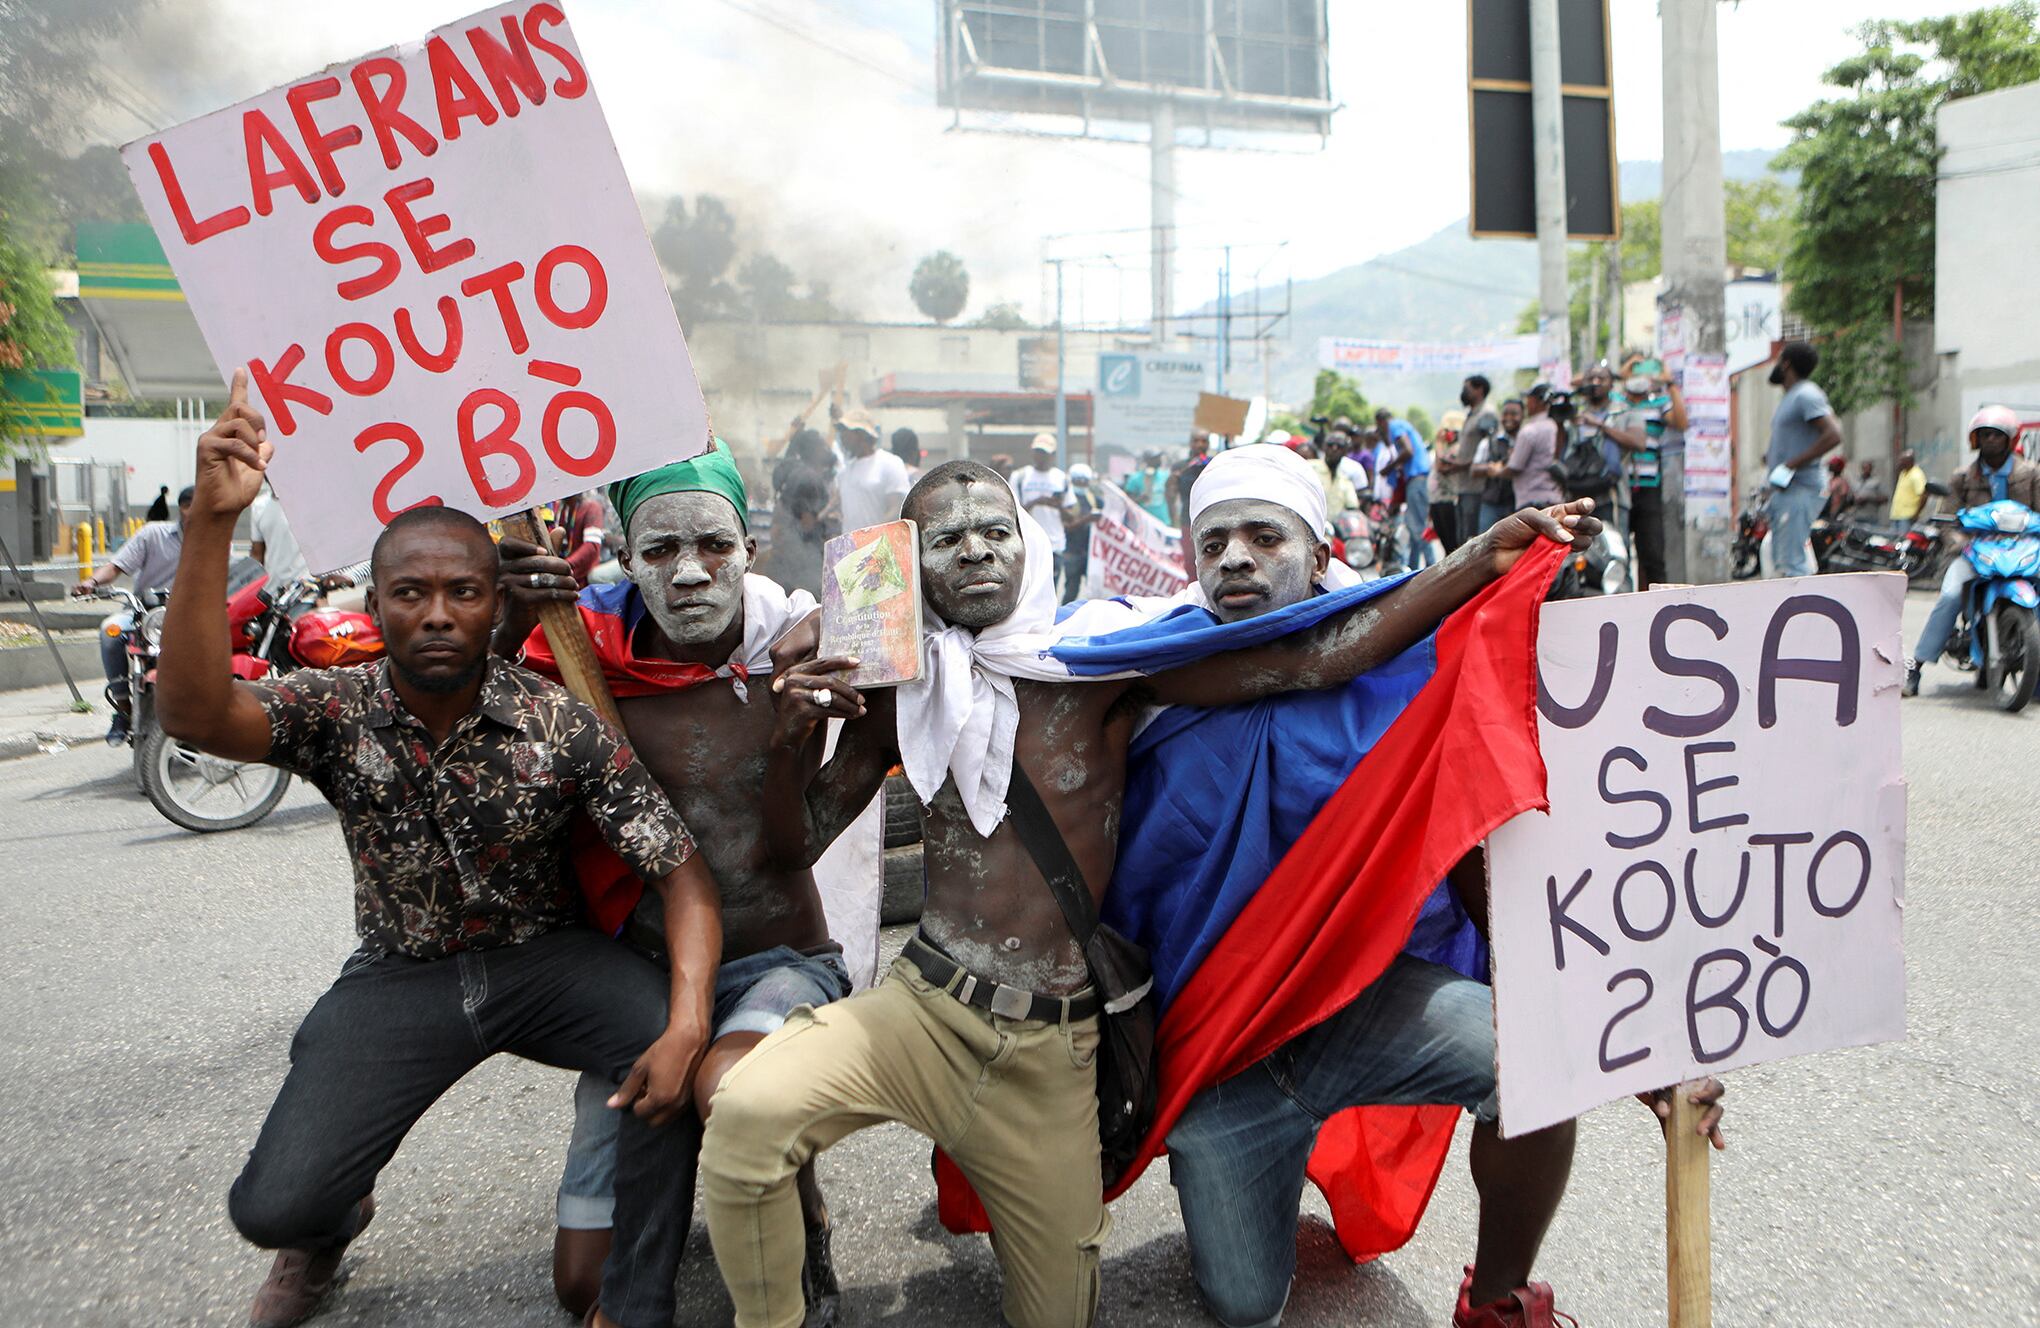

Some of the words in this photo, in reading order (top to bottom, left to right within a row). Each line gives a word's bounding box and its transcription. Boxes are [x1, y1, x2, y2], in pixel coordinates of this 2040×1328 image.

[148, 3, 587, 244] LAFRANS
[313, 179, 475, 301] SE
[248, 245, 608, 436] KOUTO
[354, 422, 442, 525] 2
[457, 360, 616, 508] BÒ
[1537, 595, 1860, 737] USA
[1598, 742, 1749, 849] SE
[1547, 831, 1871, 970] KOUTO
[1599, 969, 1653, 1072] 2
[1686, 936, 1810, 1064] BÒ
